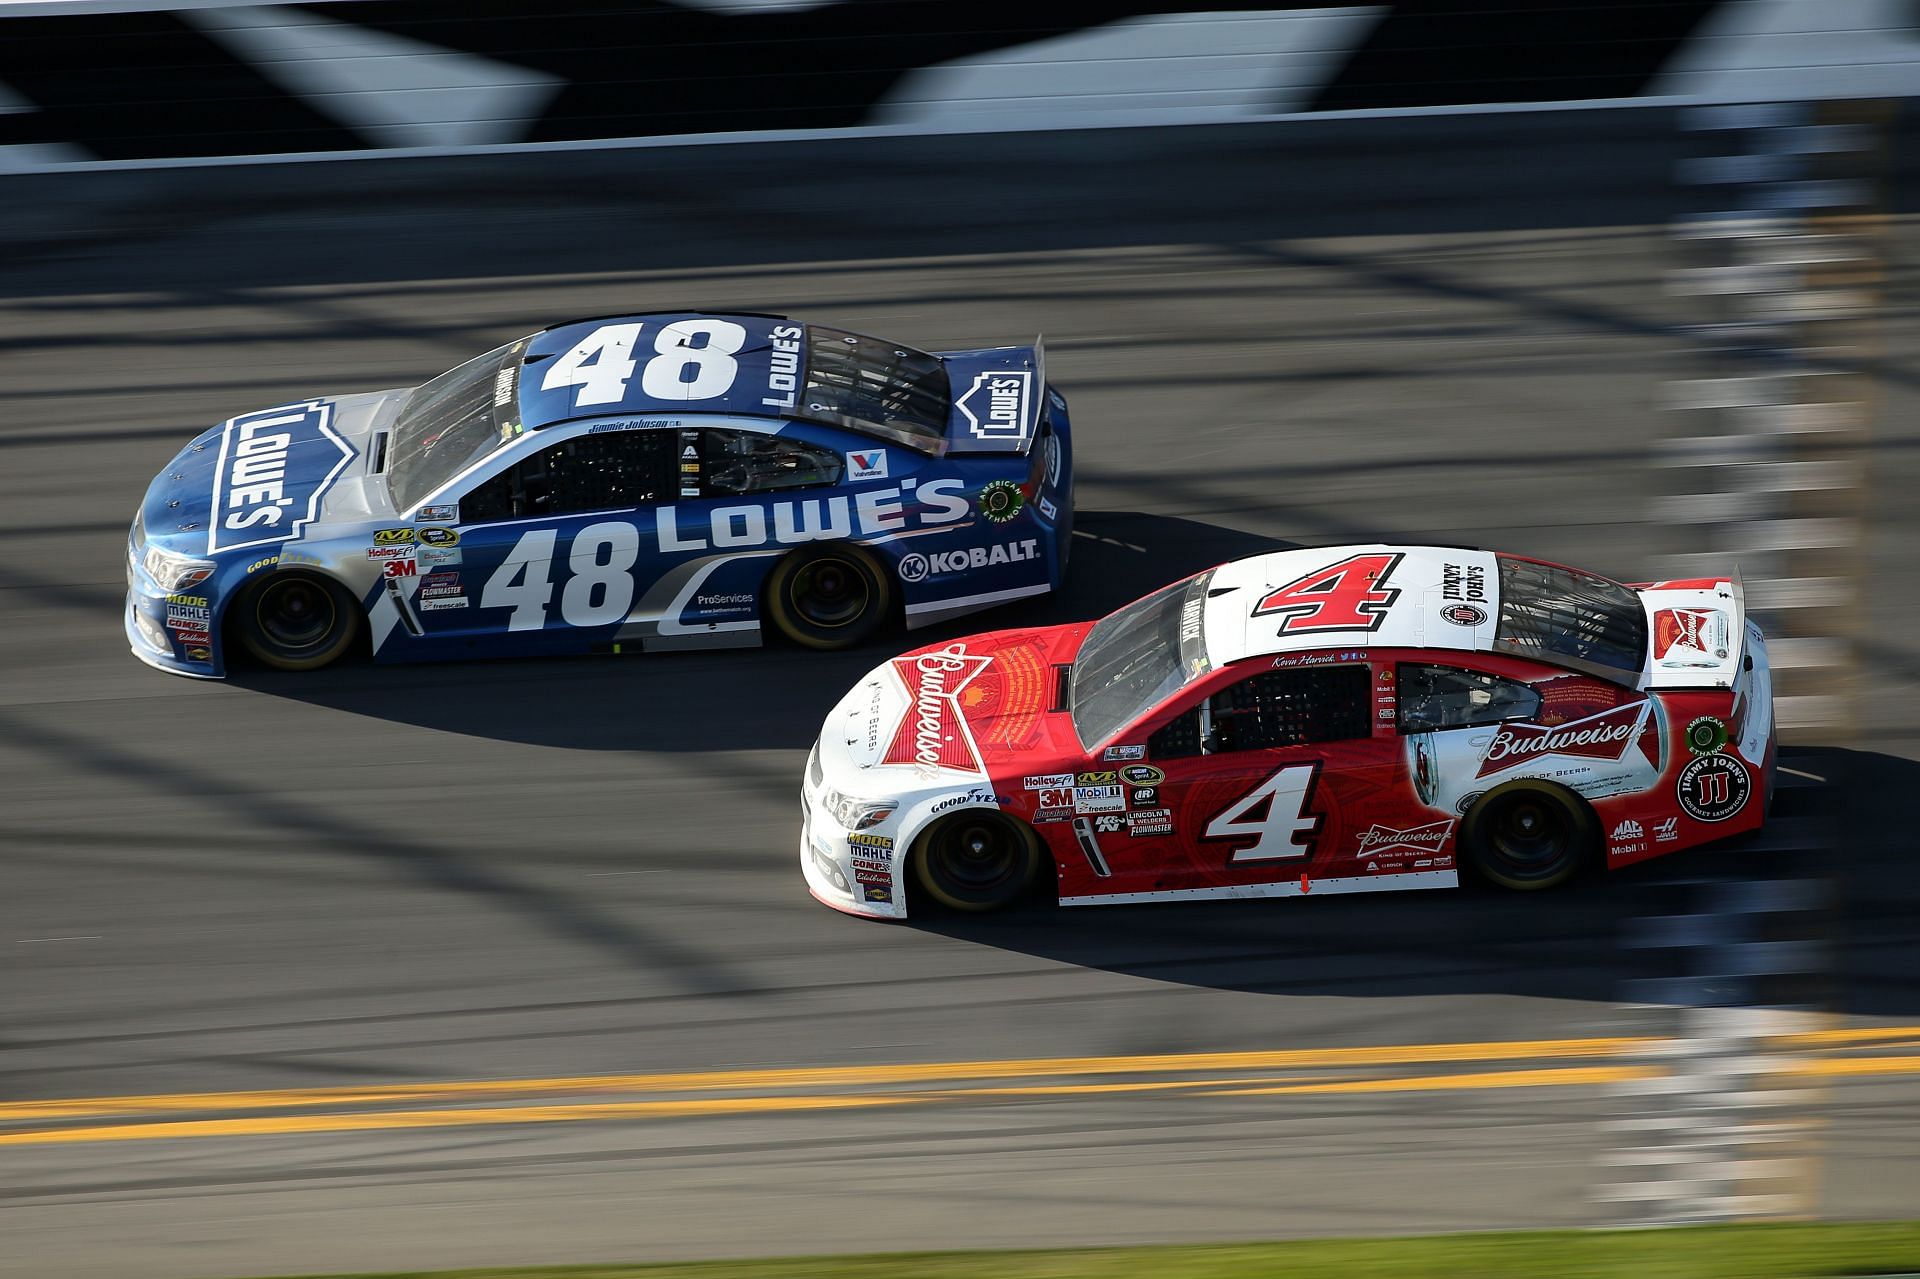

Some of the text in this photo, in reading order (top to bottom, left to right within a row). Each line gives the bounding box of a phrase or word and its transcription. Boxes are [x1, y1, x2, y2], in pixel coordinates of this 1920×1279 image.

[541, 319, 747, 408] 48
[762, 325, 802, 408] LOWE'S
[983, 378, 1021, 430] LOWE'S
[588, 418, 669, 434] Jimmie Johnson
[225, 413, 306, 530] LOWE'S
[979, 480, 1022, 500] AMERICAN
[656, 478, 970, 553] LOWE'S
[983, 504, 1022, 523] ETHANOL
[368, 547, 400, 558] Holley
[929, 539, 1038, 574] KOBALT
[384, 560, 417, 577] 3M
[480, 521, 639, 632] 48
[1443, 563, 1464, 602] JIMMY
[1466, 565, 1488, 603] JOHN'S
[165, 593, 208, 607] MOOG
[697, 594, 754, 605] ProServices
[1251, 552, 1406, 637] 4
[168, 605, 210, 620] MAHLE
[1182, 598, 1202, 643] HARVICK
[168, 619, 199, 629] COMP
[1272, 653, 1335, 668] Kevin Harvick
[915, 643, 967, 781] Budweiser
[1686, 716, 1725, 733] AMERICAN
[1468, 721, 1647, 763] Budweiser
[1688, 742, 1727, 757] ETHANOL
[1556, 766, 1587, 777] BEERS
[1682, 757, 1746, 791] JIMMY JOHN'S
[1024, 777, 1056, 788] Holley
[1697, 771, 1730, 806] JJ
[1041, 788, 1074, 808] 3M
[1076, 786, 1108, 798] Mobil
[1088, 804, 1123, 813] freescale
[1685, 789, 1746, 817] GOURMET SANDWICHES
[1129, 811, 1163, 819] LINCOLN
[1203, 763, 1319, 865] 4
[1130, 823, 1172, 837] FLOWMASTER
[1613, 820, 1644, 836] MAC
[1614, 832, 1645, 841] TOOLS
[848, 833, 892, 847] MOOG
[1356, 829, 1452, 846] Budweiser
[851, 845, 892, 860] MAHLE
[1611, 843, 1637, 855] Mobil
[852, 859, 882, 870] COMP
